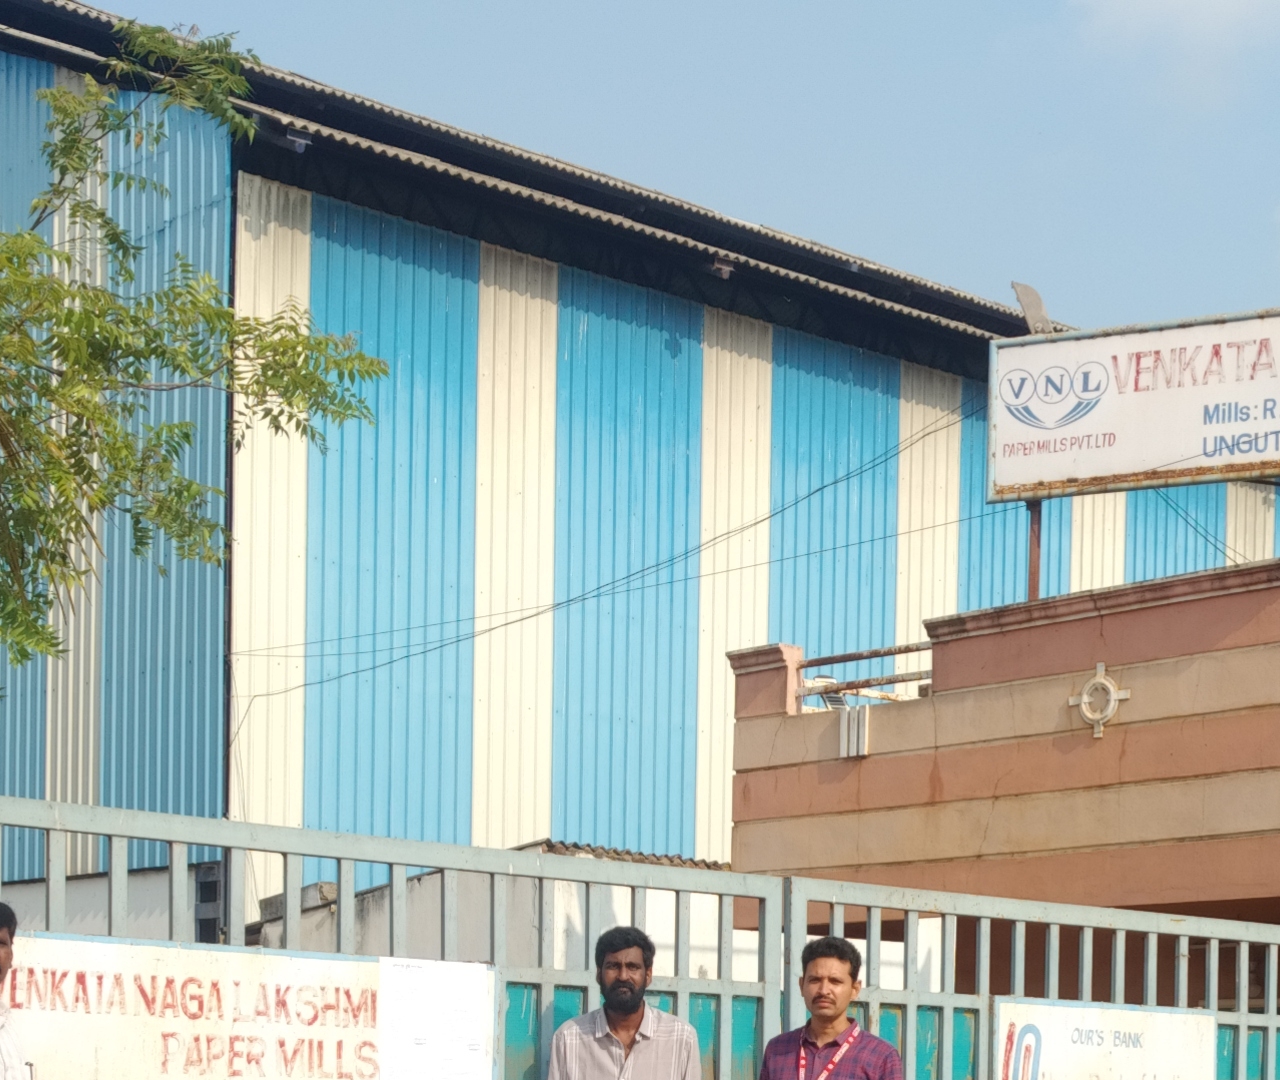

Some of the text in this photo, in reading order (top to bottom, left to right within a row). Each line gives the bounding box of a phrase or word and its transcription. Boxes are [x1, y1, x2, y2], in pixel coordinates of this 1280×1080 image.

[1111, 337, 1277, 395] VENKATA
[133, 973, 224, 1020] NAGA
[233, 979, 377, 1029] LAKSHMI
[160, 1031, 267, 1078] PAPER
[1113, 1030, 1144, 1048] BANK
